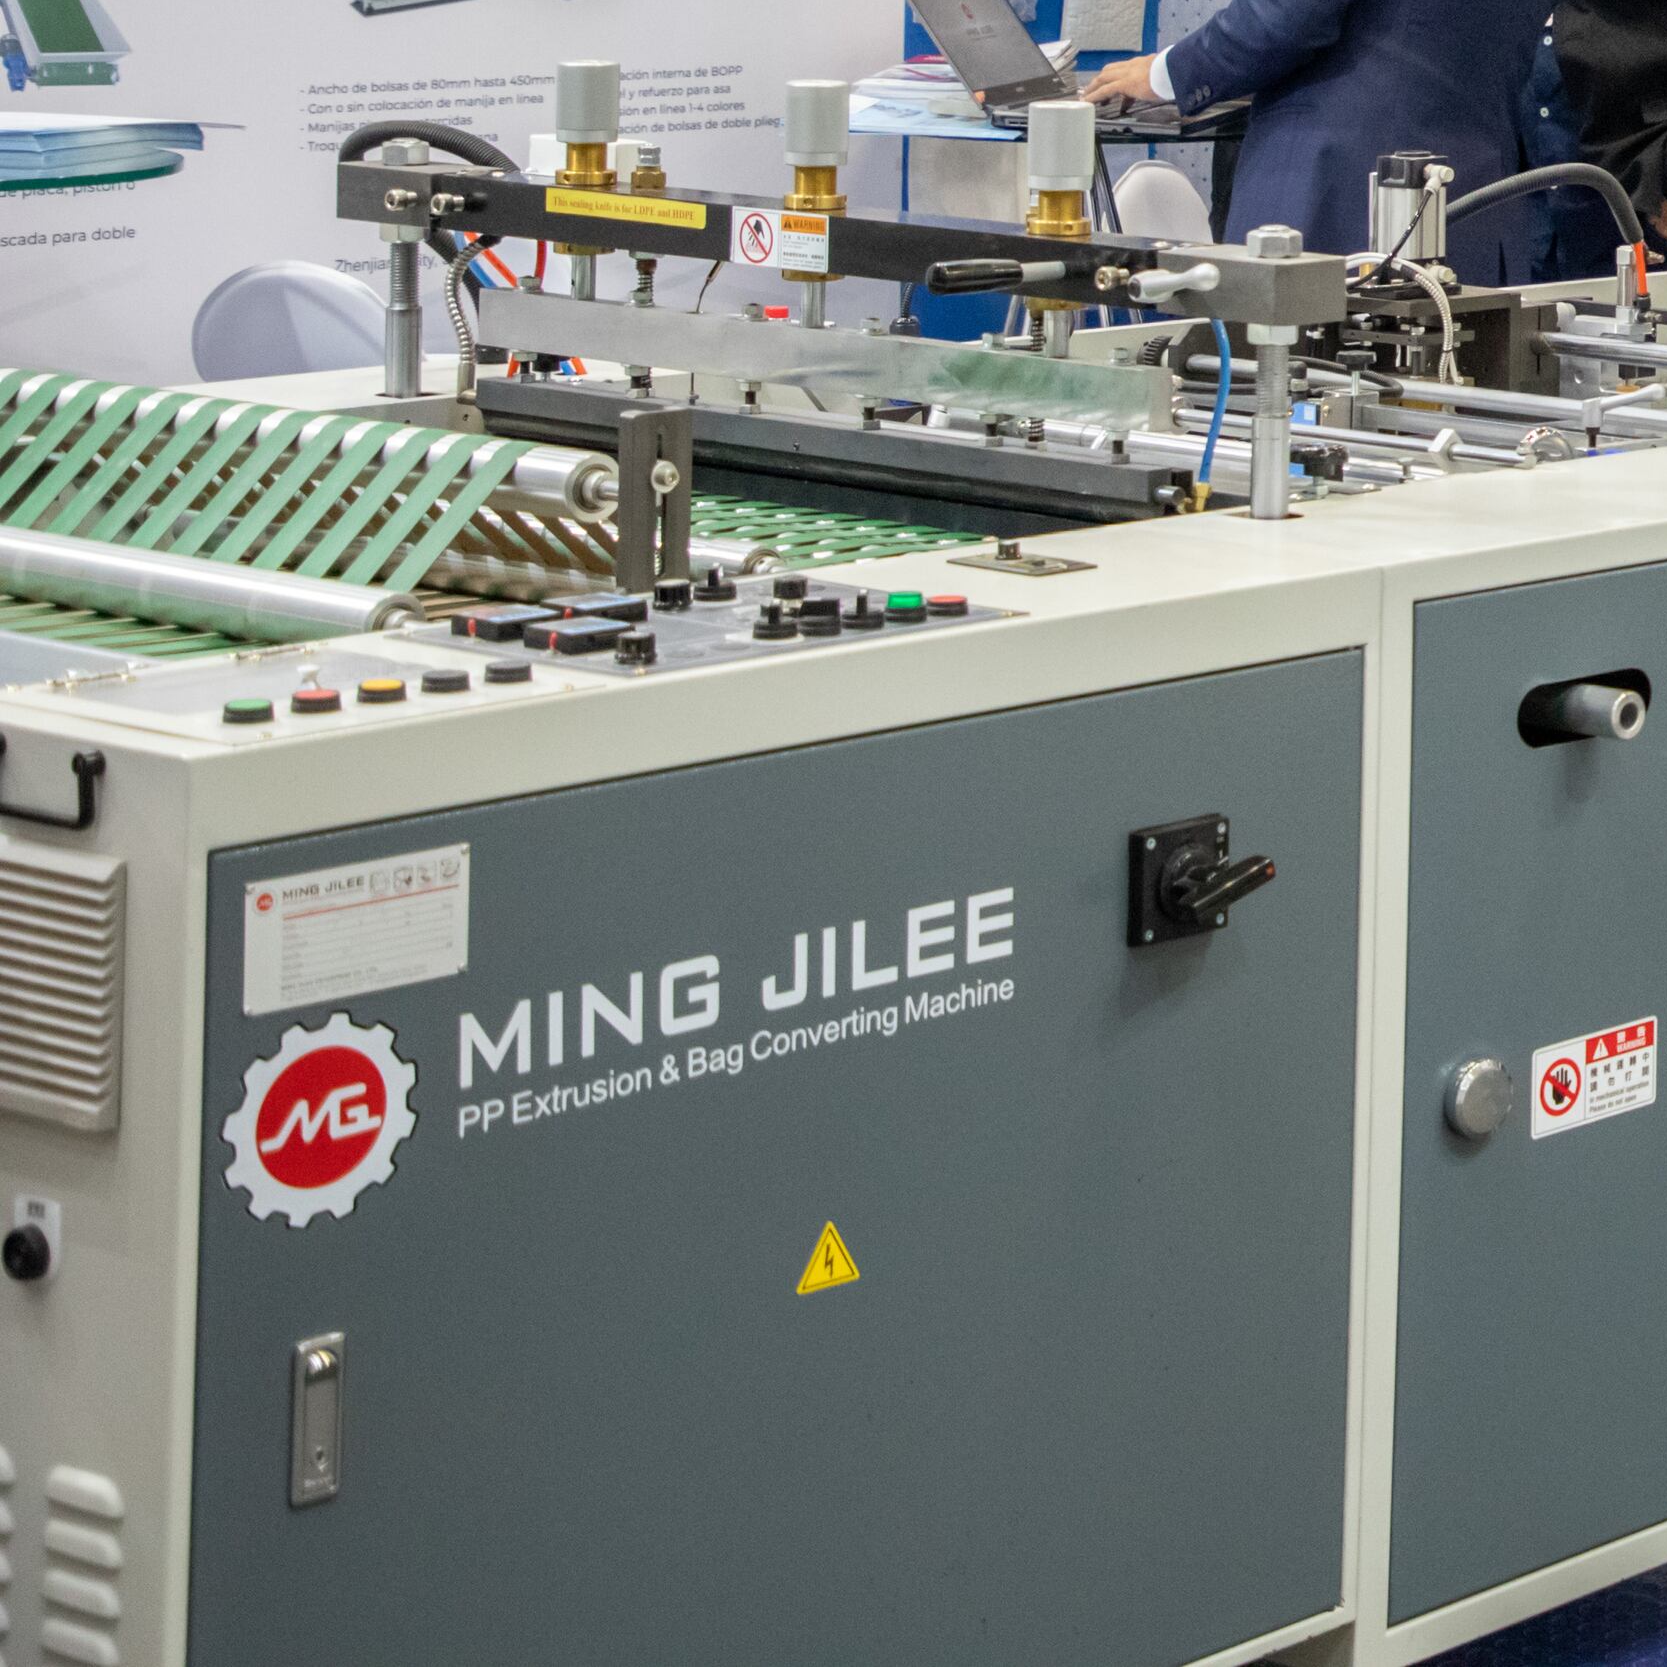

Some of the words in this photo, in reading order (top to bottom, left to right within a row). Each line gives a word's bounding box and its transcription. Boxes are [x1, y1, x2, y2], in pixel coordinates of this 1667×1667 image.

[652, 69, 692, 80] interna
[711, 65, 743, 77] BOPP
[308, 84, 348, 95] Ancho
[352, 83, 367, 94] de
[371, 80, 409, 93] bolsas
[412, 80, 427, 91] de
[474, 76, 506, 88] hasta
[509, 74, 555, 86] 450mm
[638, 87, 684, 97] refuerzo
[686, 86, 711, 97] para
[368, 99, 433, 112] colocación
[455, 95, 496, 109] manija
[706, 101, 746, 112] colores
[667, 121, 702, 132] bolsas
[553, 196, 568, 207] This
[52, 232, 87, 246] para
[91, 226, 136, 242] doble
[335, 258, 392, 274] Zhenjia
[282, 883, 319, 902] MING
[325, 875, 365, 894] JILEE
[459, 954, 720, 1090] MING
[762, 887, 1014, 1011] JILEE
[459, 1099, 506, 1140] PP
[511, 1068, 653, 1125] Extrusion
[659, 1054, 681, 1087] &
[687, 1041, 744, 1078] Bag
[750, 1000, 899, 1063] Converting
[904, 977, 1015, 1025] Machine
